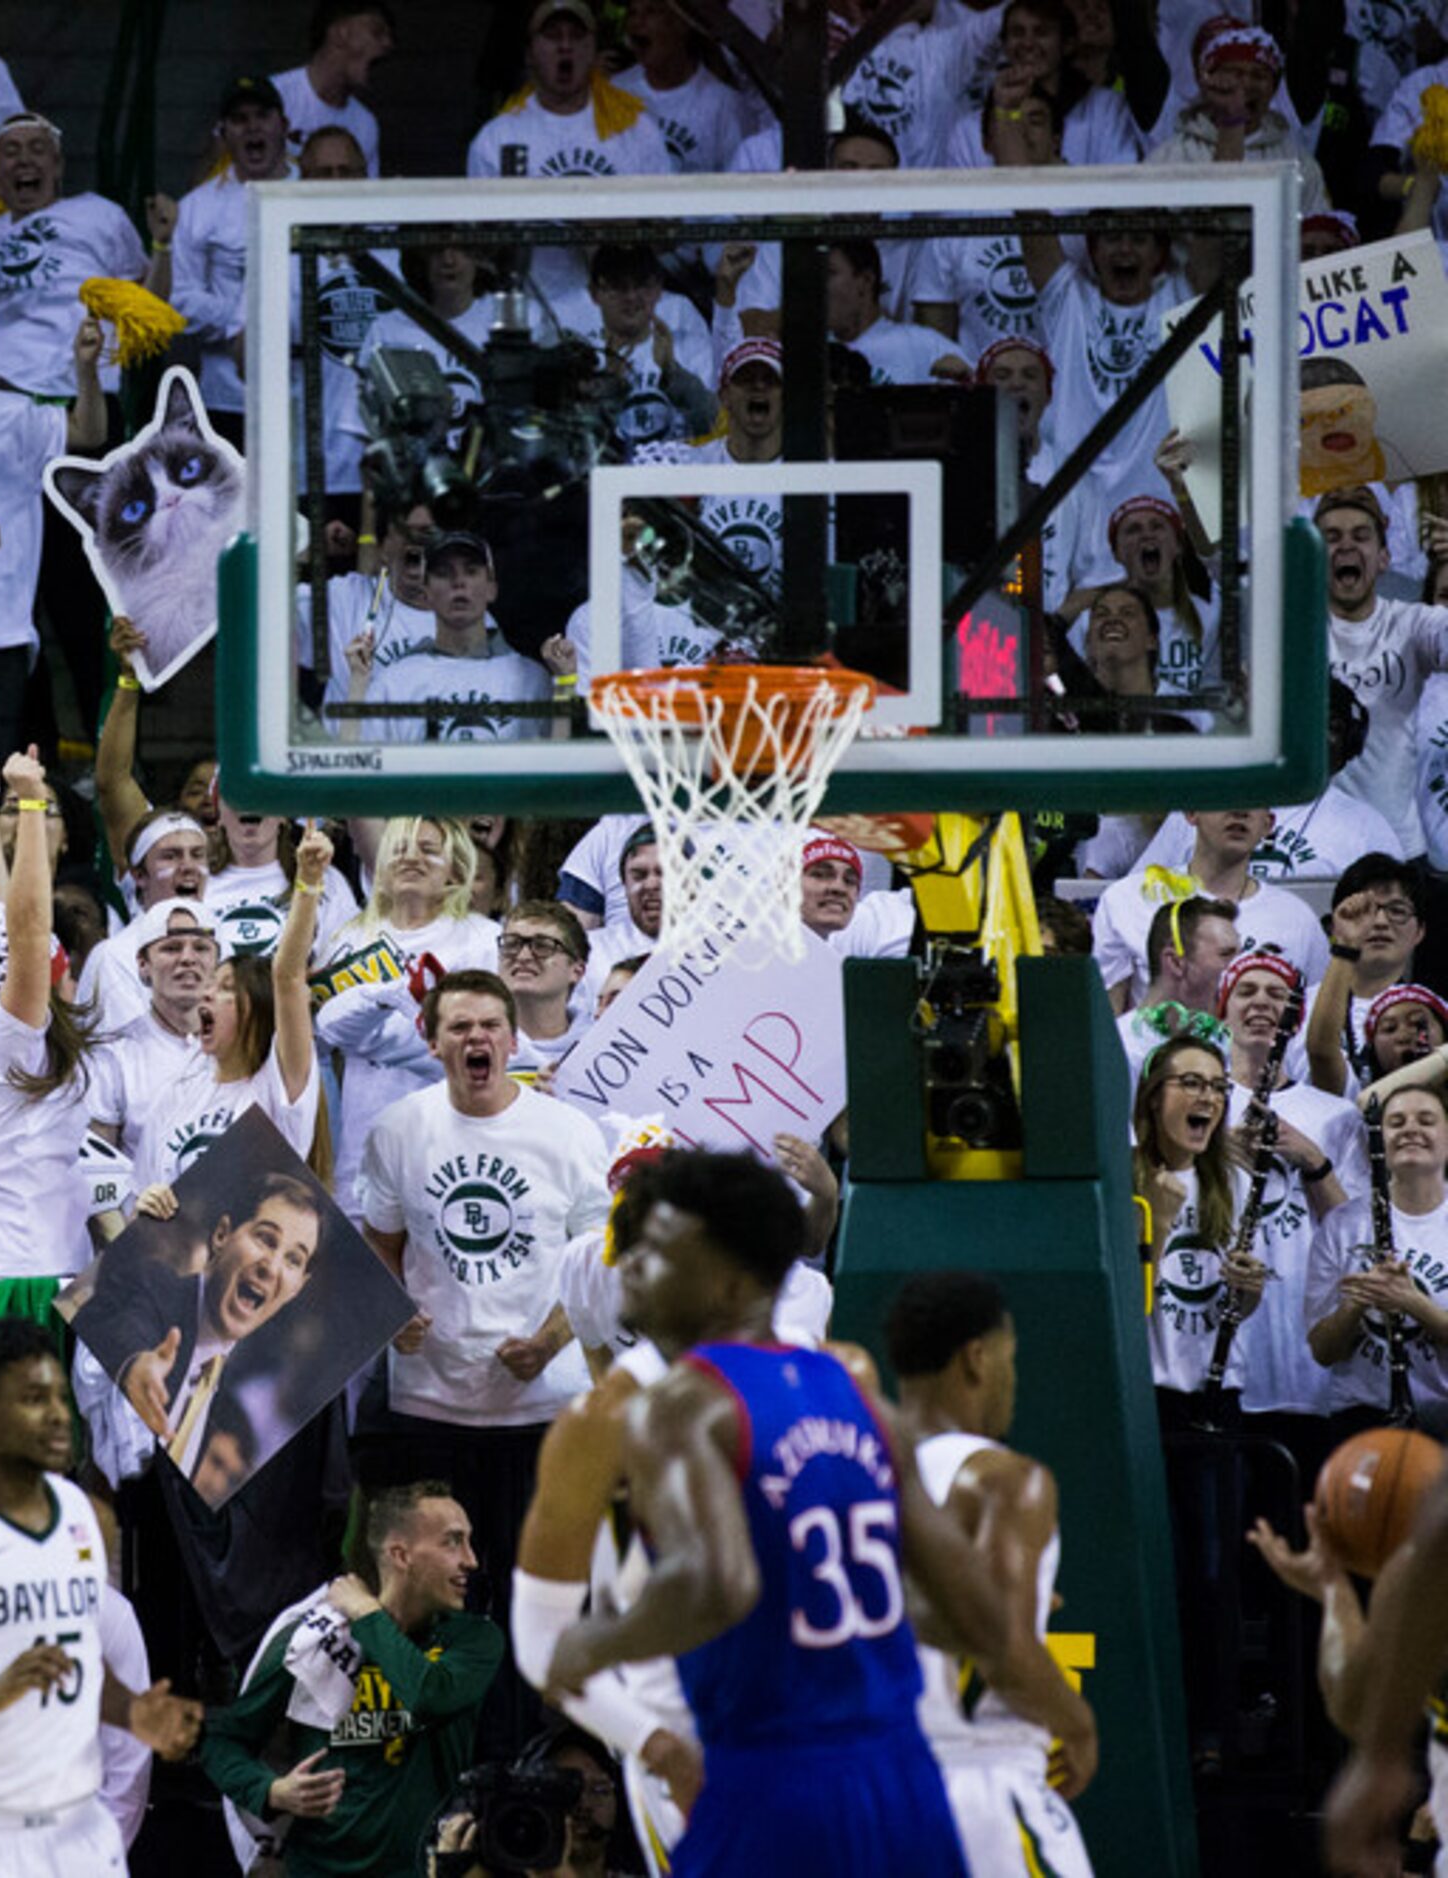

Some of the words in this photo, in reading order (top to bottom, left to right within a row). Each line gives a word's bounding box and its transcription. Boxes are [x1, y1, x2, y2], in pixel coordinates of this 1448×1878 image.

[1308, 267, 1369, 302] LIKE
[1392, 252, 1419, 284] A
[287, 751, 383, 772] SPALDING
[568, 1026, 650, 1107] VON
[656, 1075, 691, 1107] IS
[685, 1051, 714, 1079] A
[425, 1156, 469, 1200] LIVE
[476, 1154, 531, 1200] FROM
[464, 1202, 490, 1235] BU
[475, 1260, 501, 1285] TX
[502, 1229, 536, 1269] 254
[790, 1502, 904, 1649] 35
